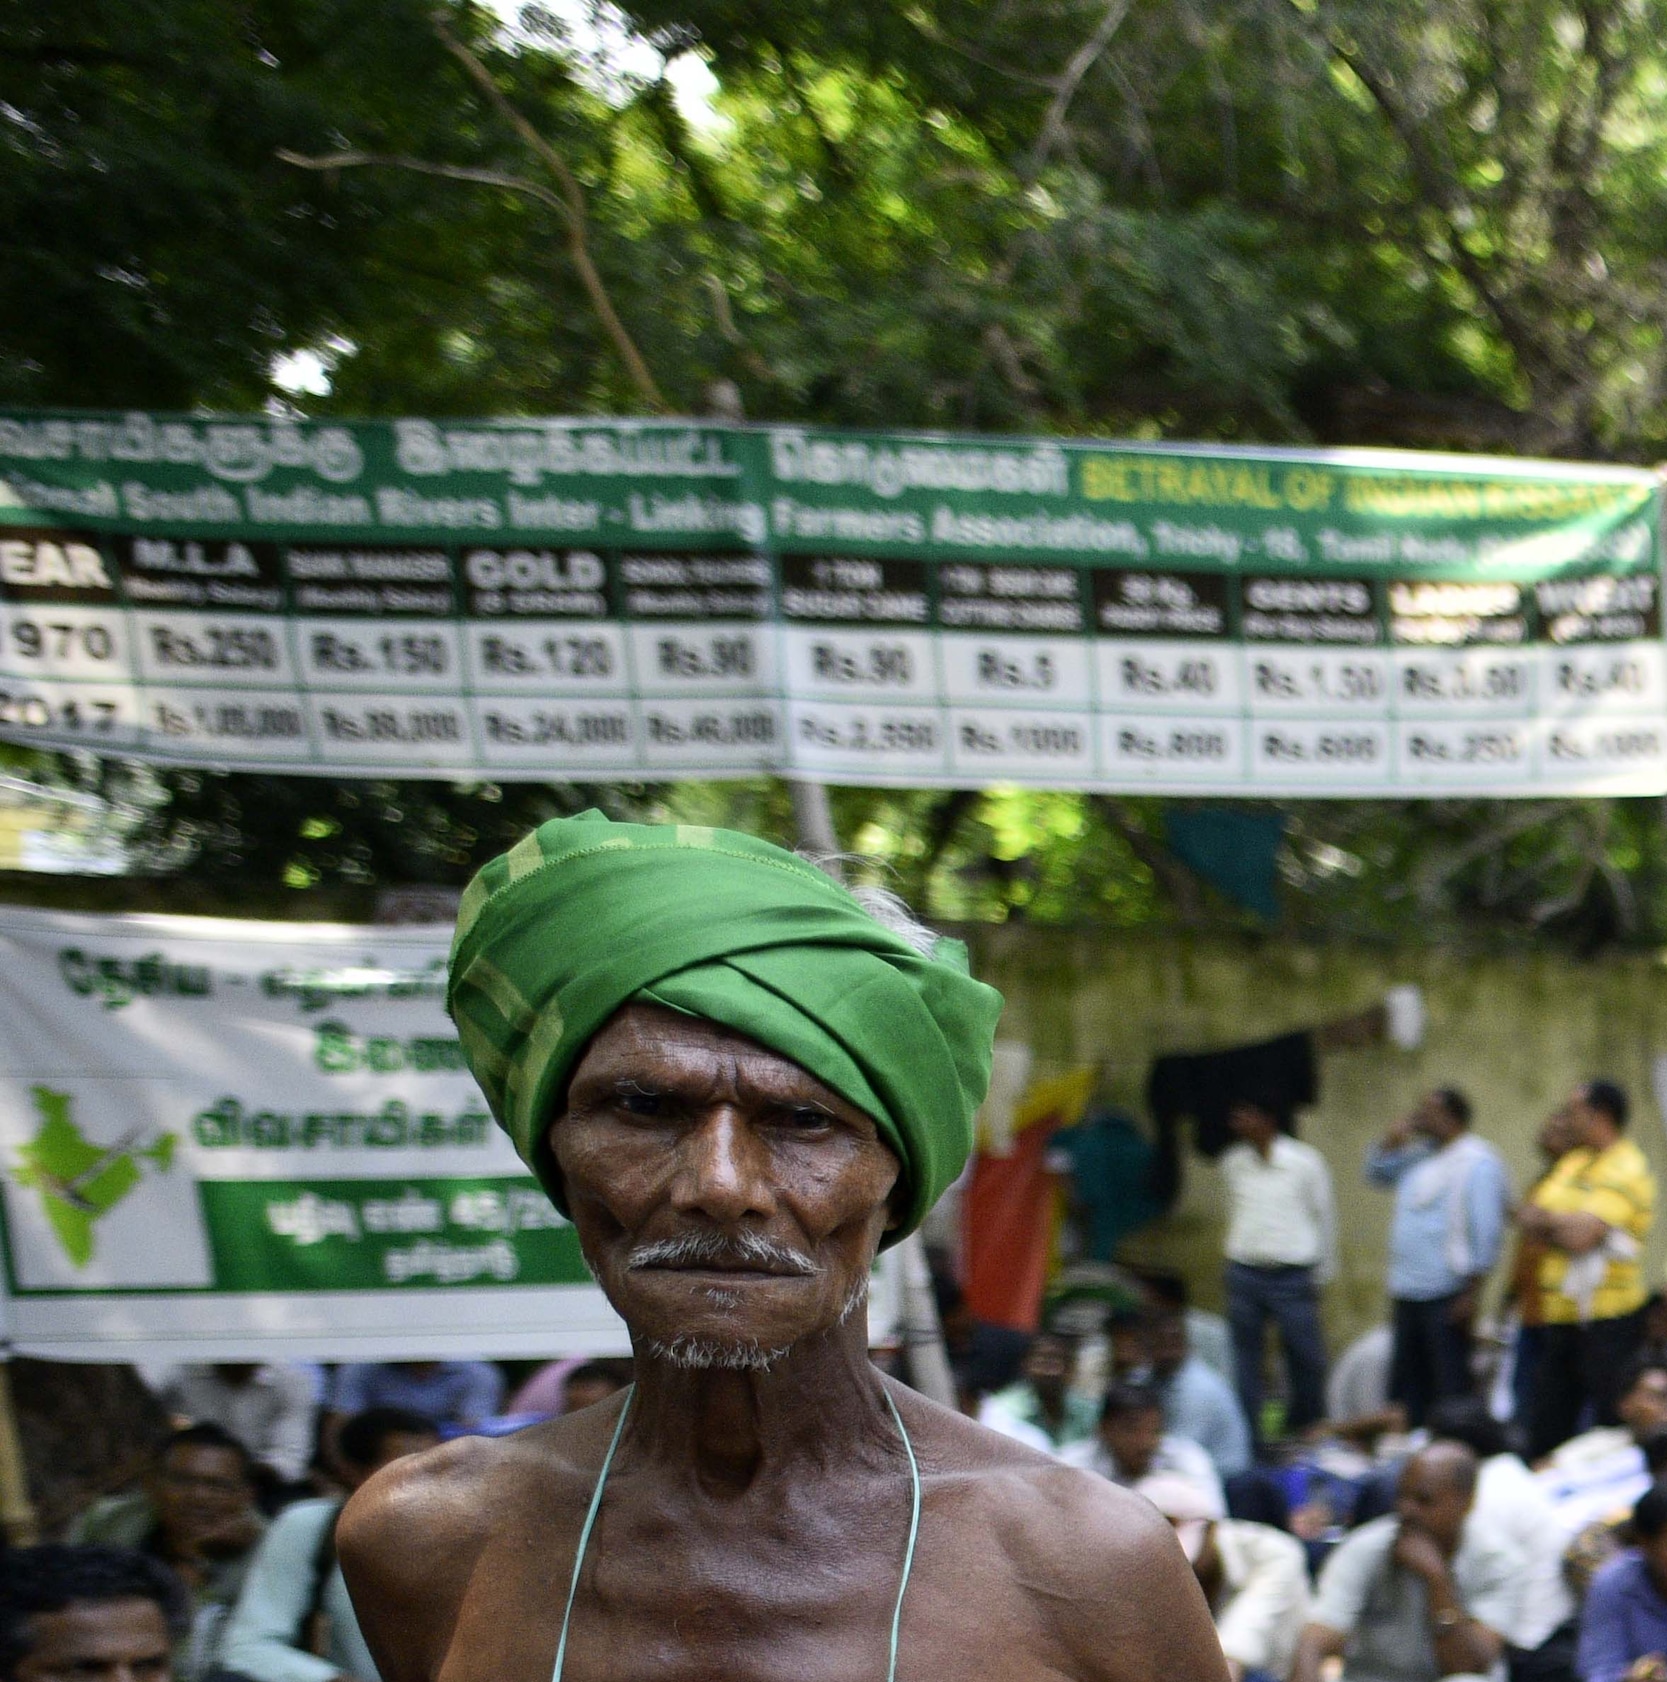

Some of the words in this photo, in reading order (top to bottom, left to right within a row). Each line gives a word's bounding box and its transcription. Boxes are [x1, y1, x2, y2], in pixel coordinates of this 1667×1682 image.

[1081, 455, 1283, 510] BETRAYAL
[1285, 466, 1333, 513] OF
[121, 480, 243, 523] South
[245, 485, 374, 526] Indian
[375, 487, 500, 531] Rivers
[506, 489, 600, 532] Inter
[629, 490, 768, 546] Linking
[771, 495, 926, 545] Farmers
[0, 540, 113, 589] EAR
[464, 549, 606, 592] GOLD
[9, 619, 115, 664] 970
[193, 1096, 490, 1152] விவசாயிகள்
